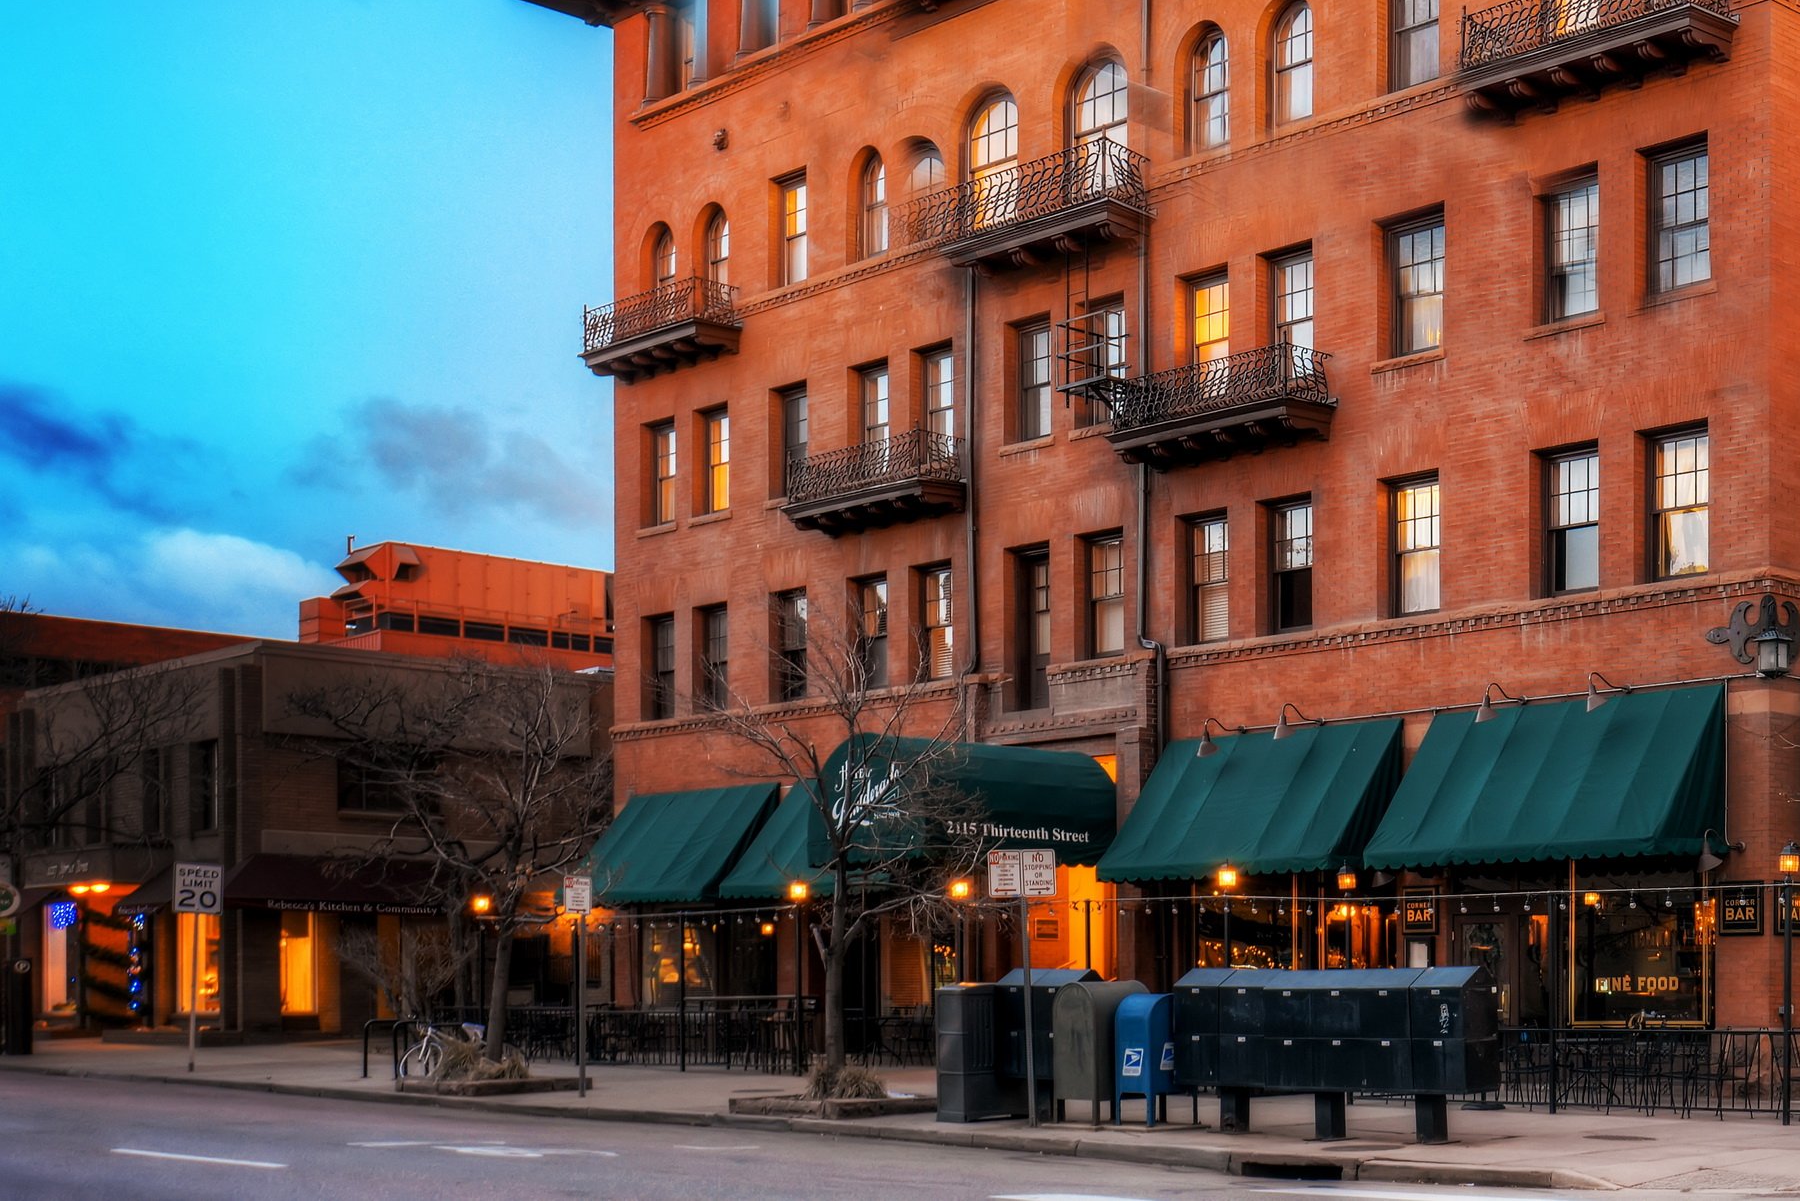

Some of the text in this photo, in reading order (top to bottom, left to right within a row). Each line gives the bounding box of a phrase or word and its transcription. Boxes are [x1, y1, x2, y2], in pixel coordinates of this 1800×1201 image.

[946, 821, 1090, 843] 2115 Thirteenth Street
[989, 852, 999, 862] NO
[1031, 853, 1044, 862] NO
[179, 868, 219, 878] SPEED
[182, 879, 214, 888] LIMIT
[178, 889, 217, 908] 20
[1725, 899, 1756, 907] CORER
[267, 899, 315, 910] Rebecca's
[318, 901, 361, 912] Kitchen
[363, 903, 373, 912] &
[376, 903, 438, 915] Community
[1407, 909, 1431, 922] BAR
[1725, 907, 1755, 921] BAR
[1596, 976, 1679, 992] FINE FOOD
